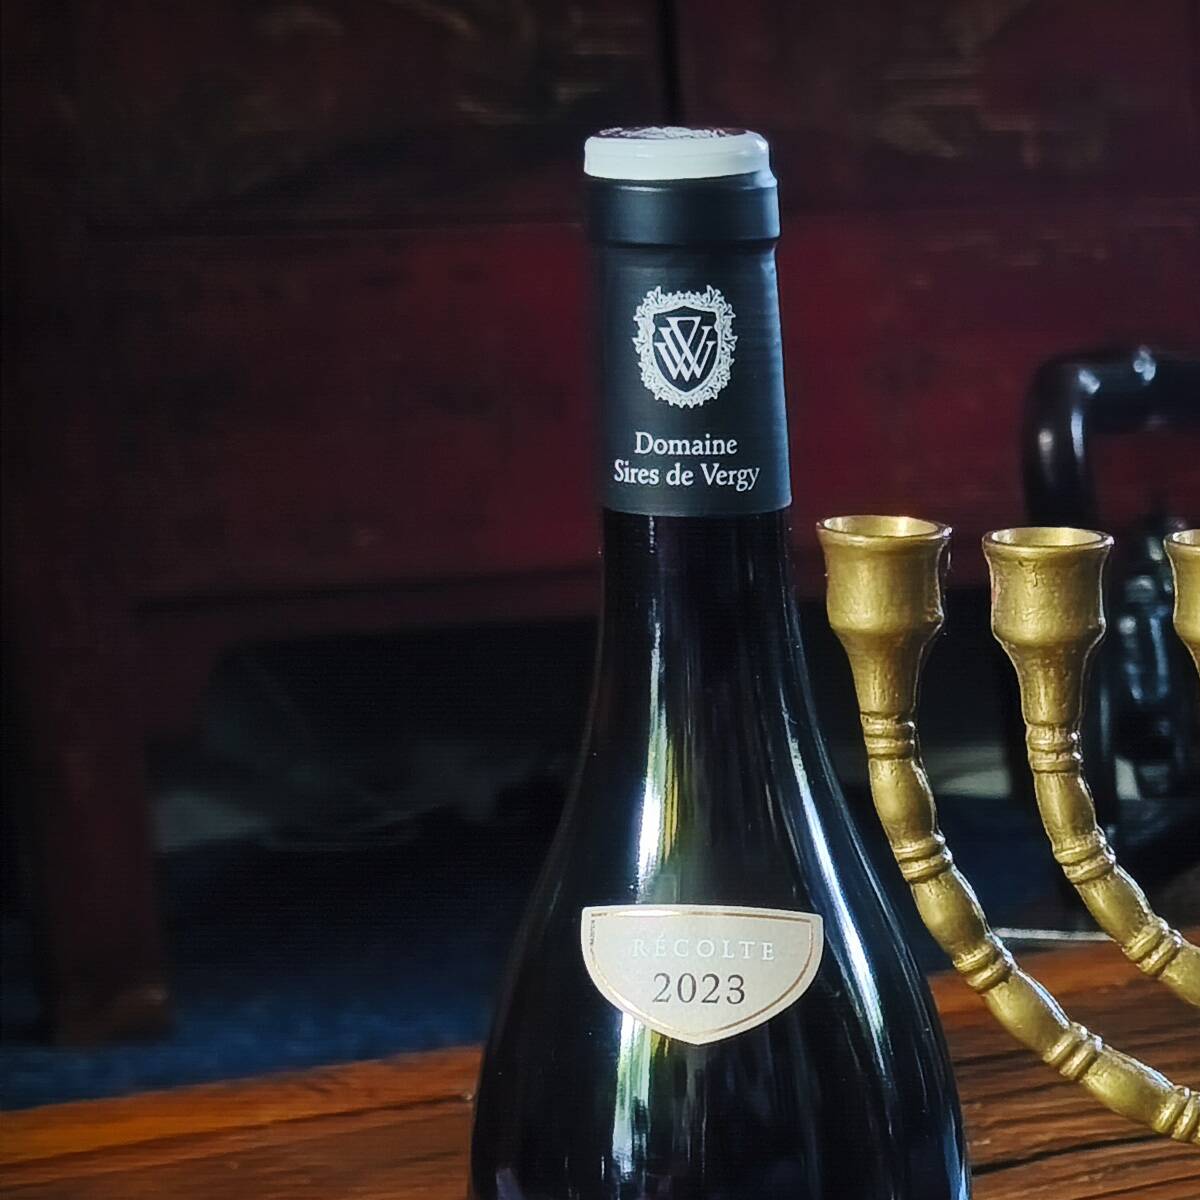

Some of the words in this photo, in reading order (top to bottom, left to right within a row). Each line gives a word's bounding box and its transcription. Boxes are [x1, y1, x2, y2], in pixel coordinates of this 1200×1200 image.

[634, 431, 738, 456] Domaine
[614, 459, 660, 486] Sires
[666, 461, 694, 487] de
[702, 463, 760, 492] Vergy
[632, 934, 776, 961] RÉCOLTE
[652, 972, 746, 1005] 2023
